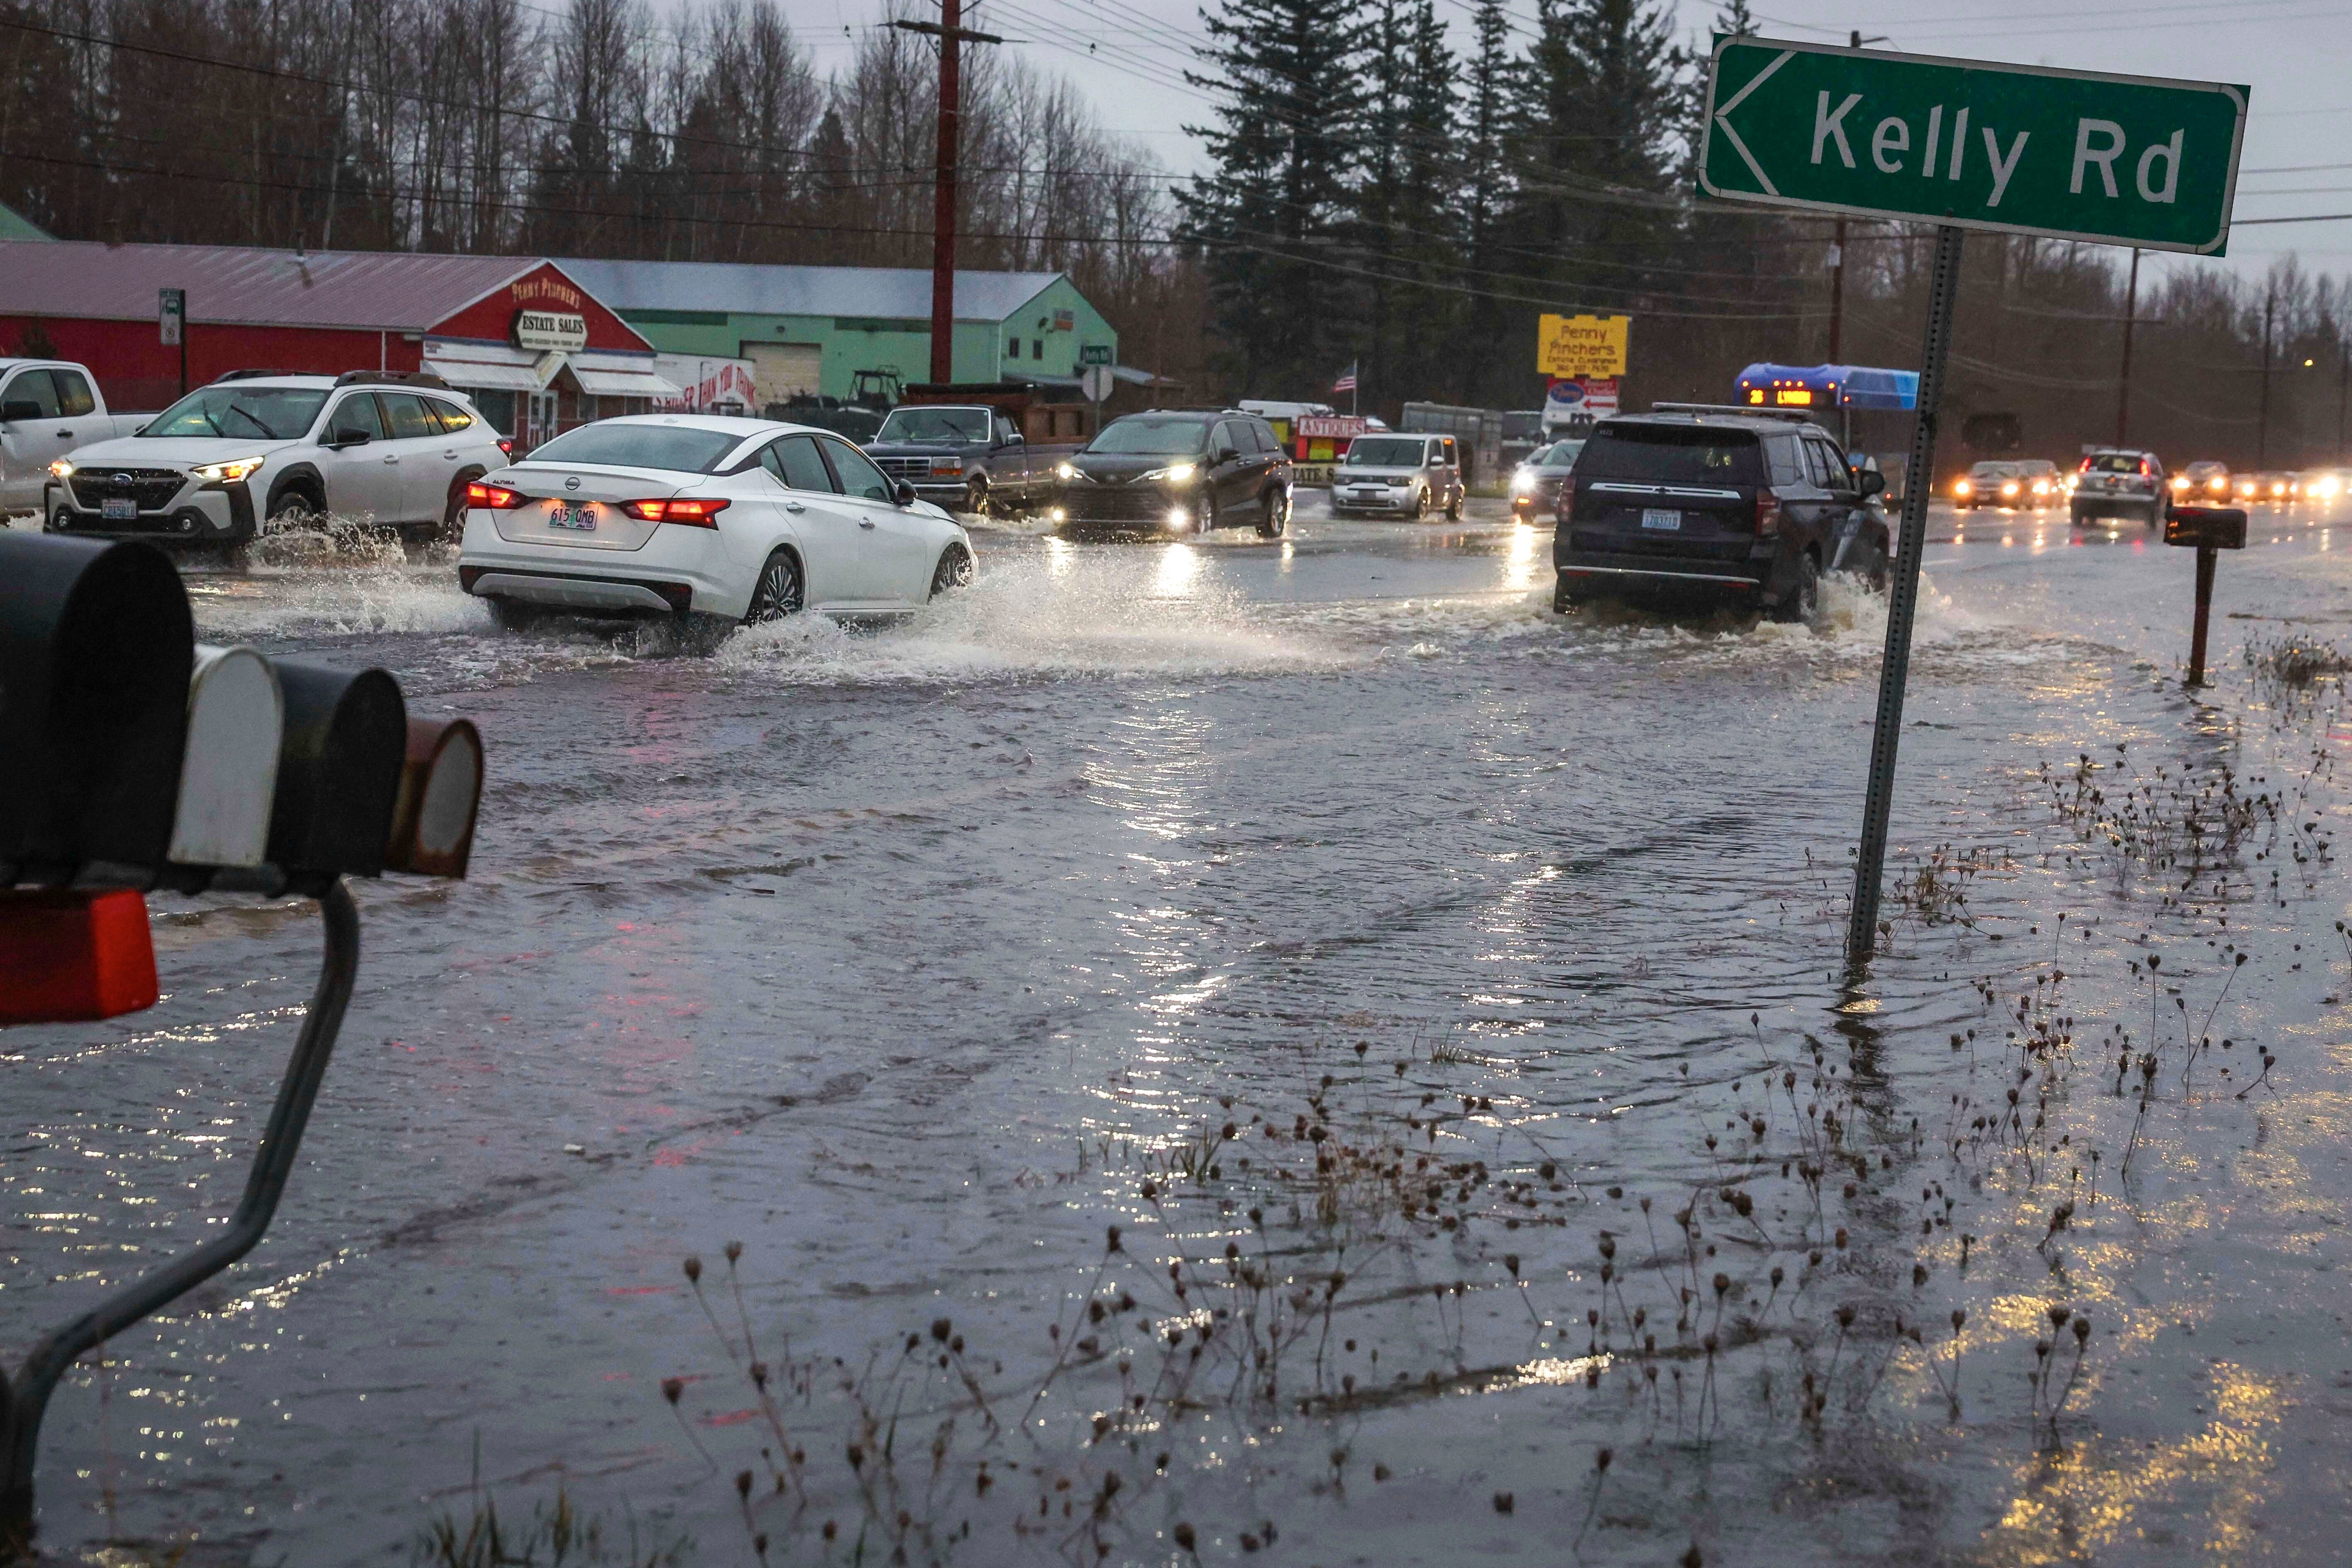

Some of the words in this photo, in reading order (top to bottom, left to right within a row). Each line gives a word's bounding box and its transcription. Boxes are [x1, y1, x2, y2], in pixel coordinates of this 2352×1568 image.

[1810, 90, 2031, 207] Kelly
[2070, 117, 2184, 204] Rd
[522, 316, 555, 331] ESTATE
[559, 318, 584, 334] SALES
[1561, 325, 1607, 343] Penny
[1549, 340, 1616, 355] Pinchers
[1300, 417, 1366, 436] ANTIQUES
[1292, 468, 1320, 482] TATE
[551, 508, 570, 521] 615
[576, 509, 595, 523] QMB
